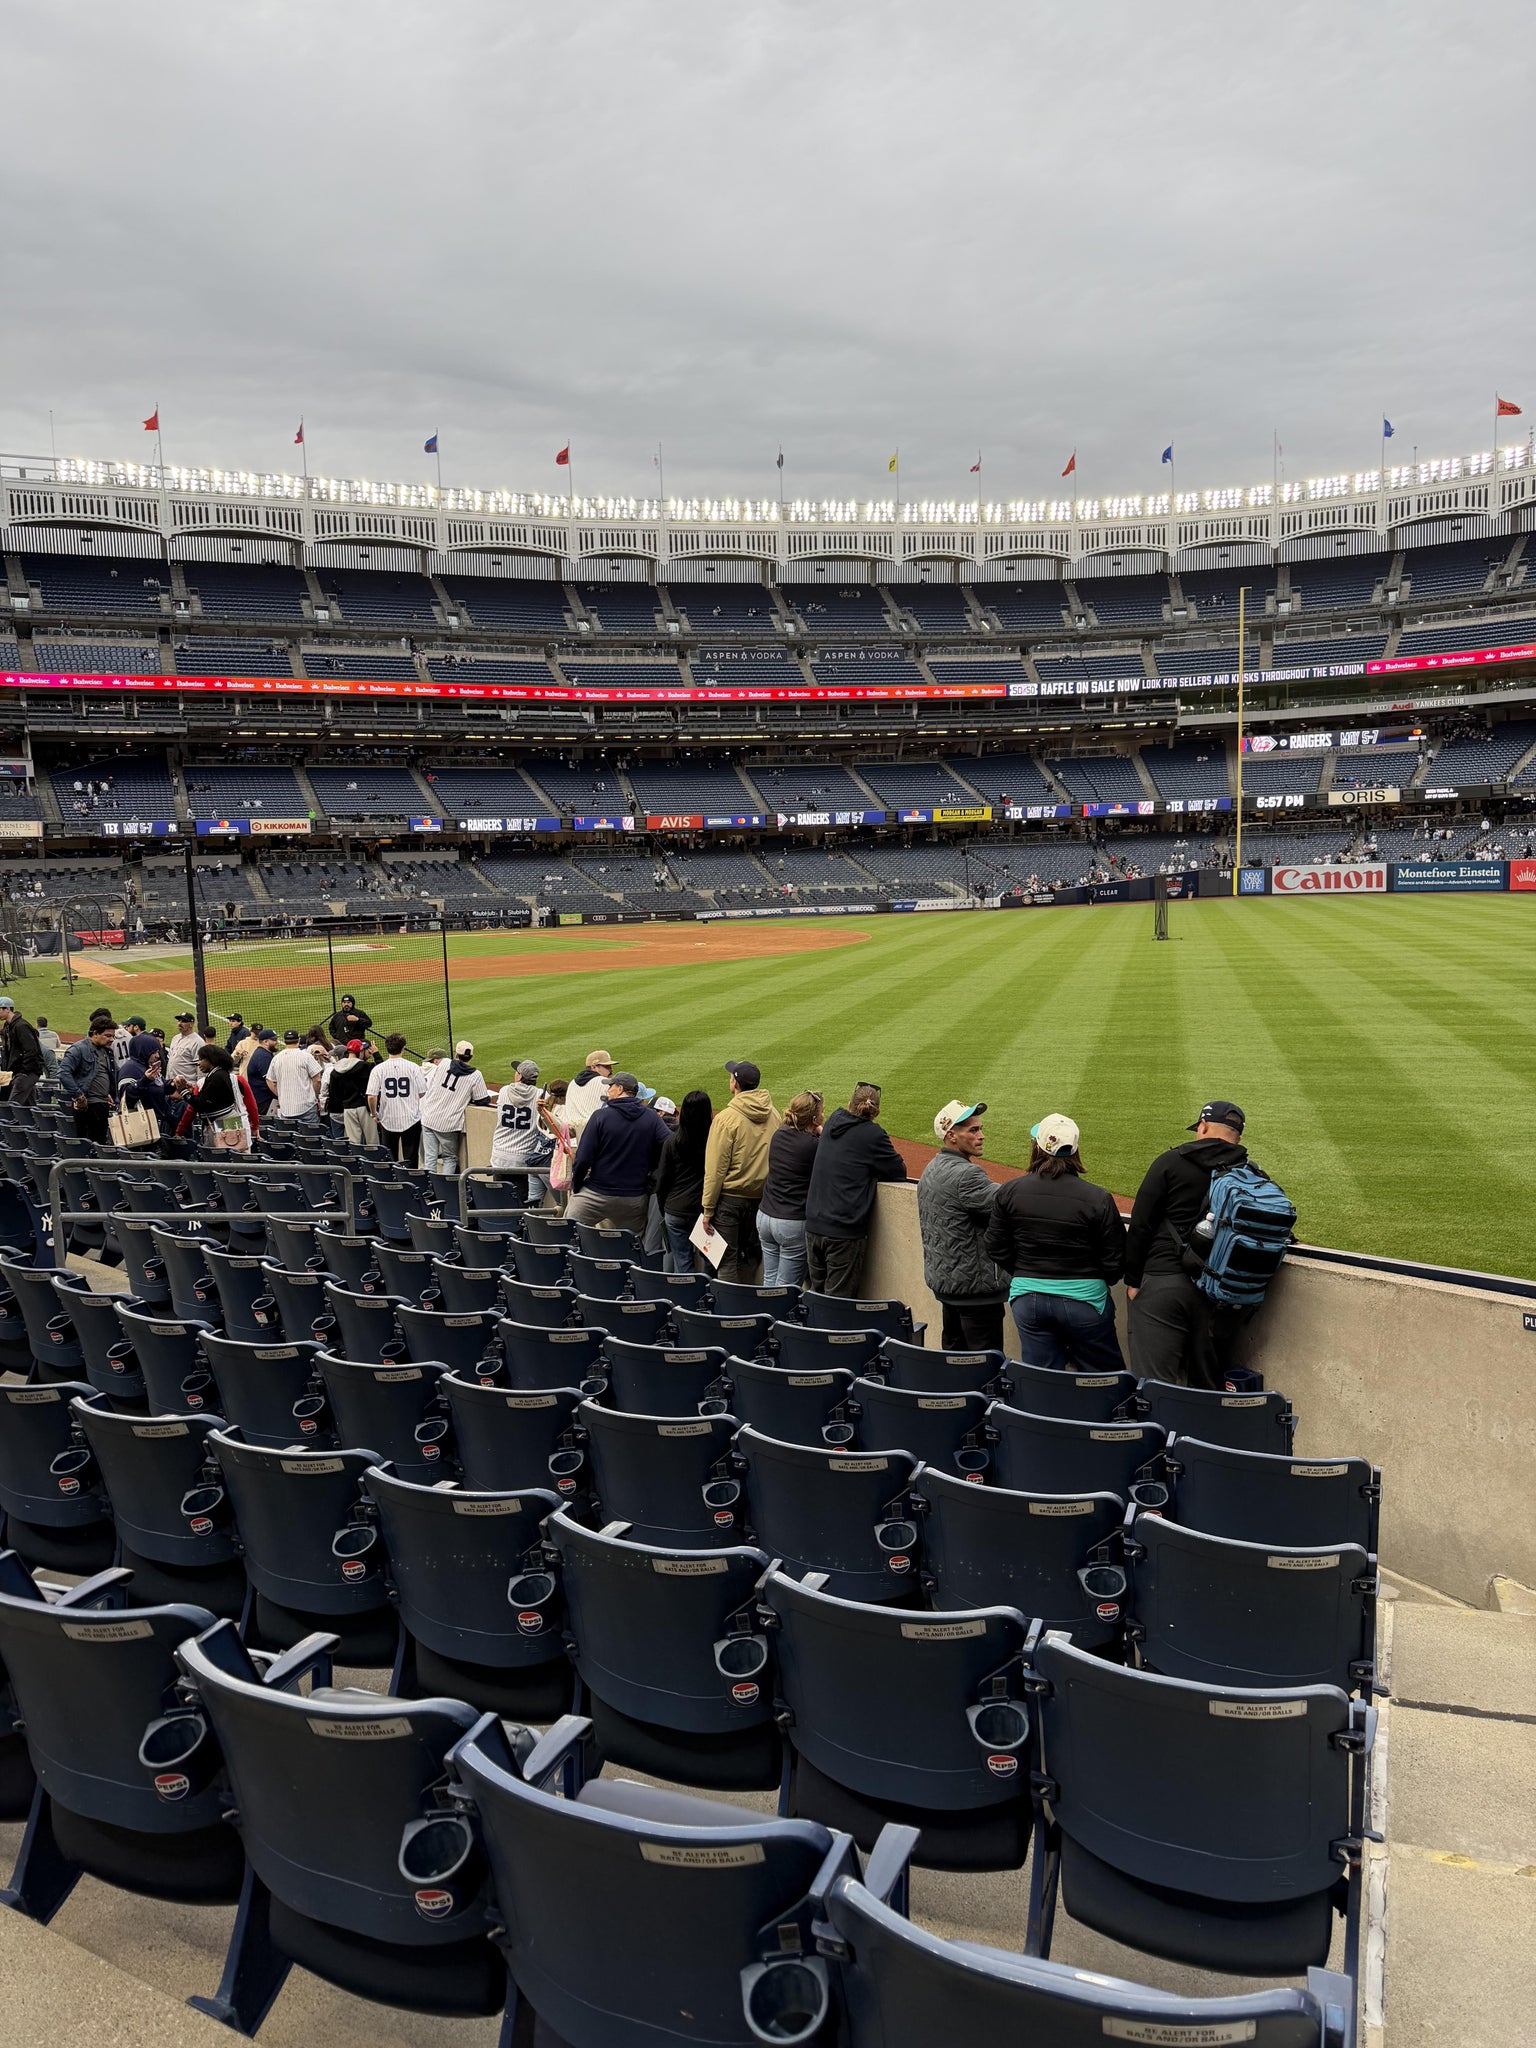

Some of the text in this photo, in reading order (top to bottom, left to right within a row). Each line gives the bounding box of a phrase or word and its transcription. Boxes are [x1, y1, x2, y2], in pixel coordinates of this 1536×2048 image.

[868, 651, 900, 659] VODKA
[1500, 650, 1534, 658] Budweiser
[1385, 662, 1417, 670] Budweiser
[1442, 656, 1475, 665] Budweiser
[1142, 664, 1364, 689] LOOK FOR SELLERS AND KISKS THROUGHOUT THE STADIUM
[1040, 679, 1140, 695] RAFFLE ON SALE NOW
[1391, 697, 1465, 710] Audi YANKEES CLUB
[1290, 729, 1380, 749] RANGERS MAY 5-7
[1256, 794, 1304, 808] 5:57 PM
[1342, 790, 1386, 803] ORIS
[1170, 800, 1184, 812] TEX
[1204, 799, 1218, 811] 5-7
[797, 812, 830, 825] RANGERS
[851, 811, 865, 824] 5-7
[1009, 807, 1023, 819] TEX
[1043, 806, 1057, 818] 5-7
[103, 823, 119, 834] TEX
[139, 822, 153, 834] 5-7
[467, 818, 503, 831] RANGERS
[523, 818, 537, 831] 5-7
[660, 816, 691, 828] AVIS
[1398, 866, 1500, 878] Montefiore Einstein
[1242, 877, 1263, 885] YORK
[1274, 868, 1384, 891] Canon
[116, 1040, 131, 1060] 11
[384, 1077, 410, 1099] 99
[441, 1073, 461, 1092] 11
[501, 1104, 531, 1130] 22
[192, 1521, 211, 1529] PEPSI
[343, 1565, 364, 1574] PEPSI
[734, 1688, 758, 1697] PEPSI
[989, 1761, 1016, 1769] PEPSI
[157, 1780, 188, 1791] PEPSI
[659, 1854, 745, 1864] BATS AND/OR BALLS
[417, 1896, 450, 1907] PEPSI
